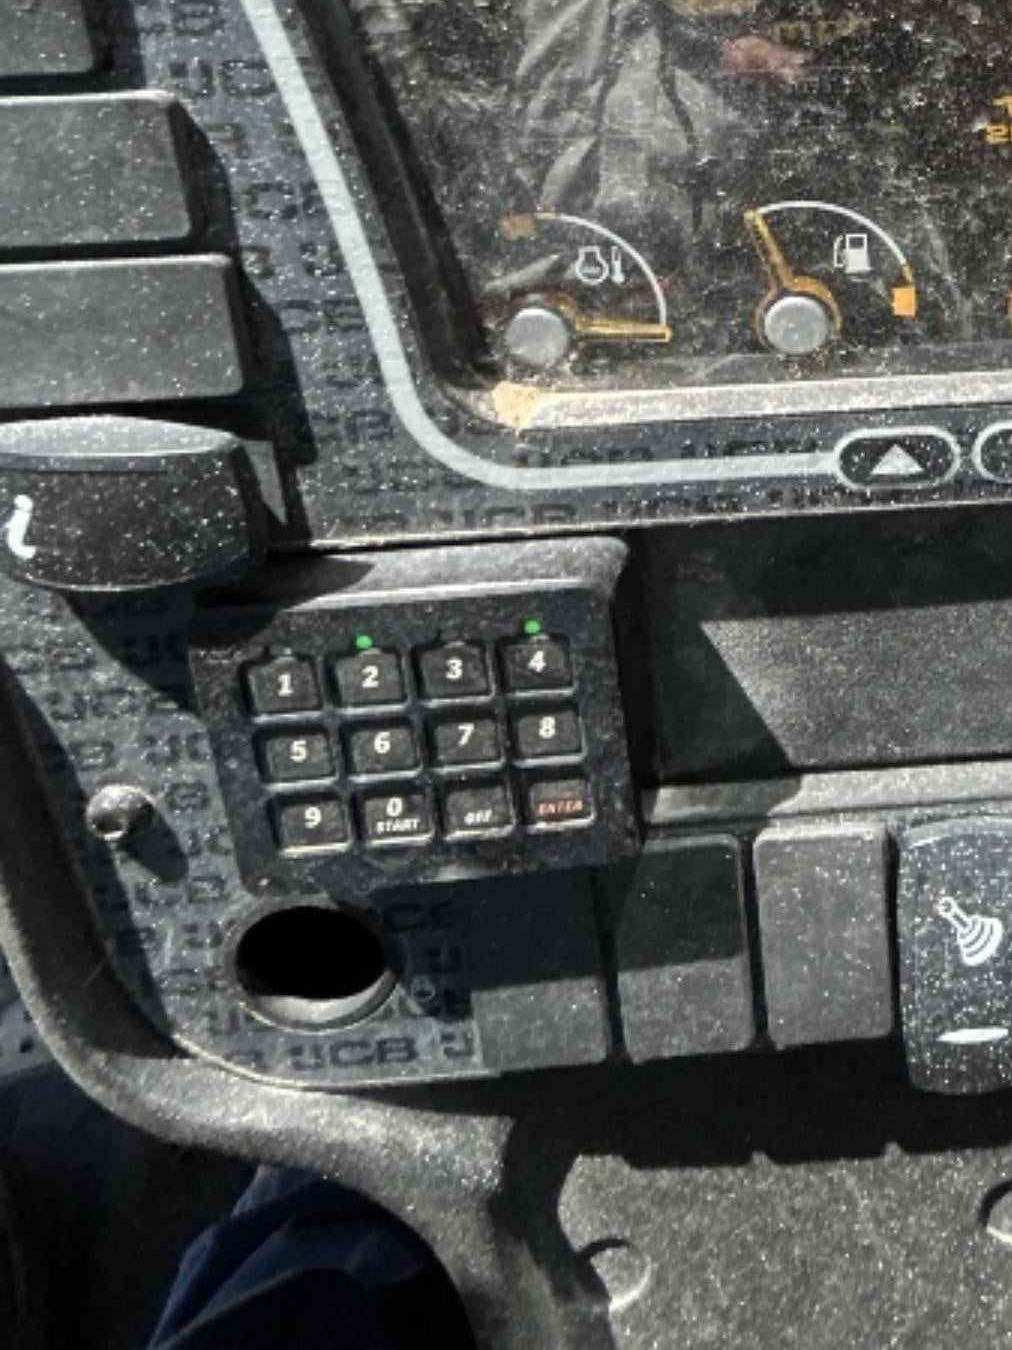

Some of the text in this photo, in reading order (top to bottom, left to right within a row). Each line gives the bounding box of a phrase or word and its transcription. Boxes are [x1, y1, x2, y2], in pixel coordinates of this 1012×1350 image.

[277, 649, 546, 696] 1 2 3 4
[290, 716, 557, 762] 5 6 7 8
[304, 797, 403, 829] 9 0
[375, 817, 421, 834] START
[289, 1036, 420, 1070] JCB
